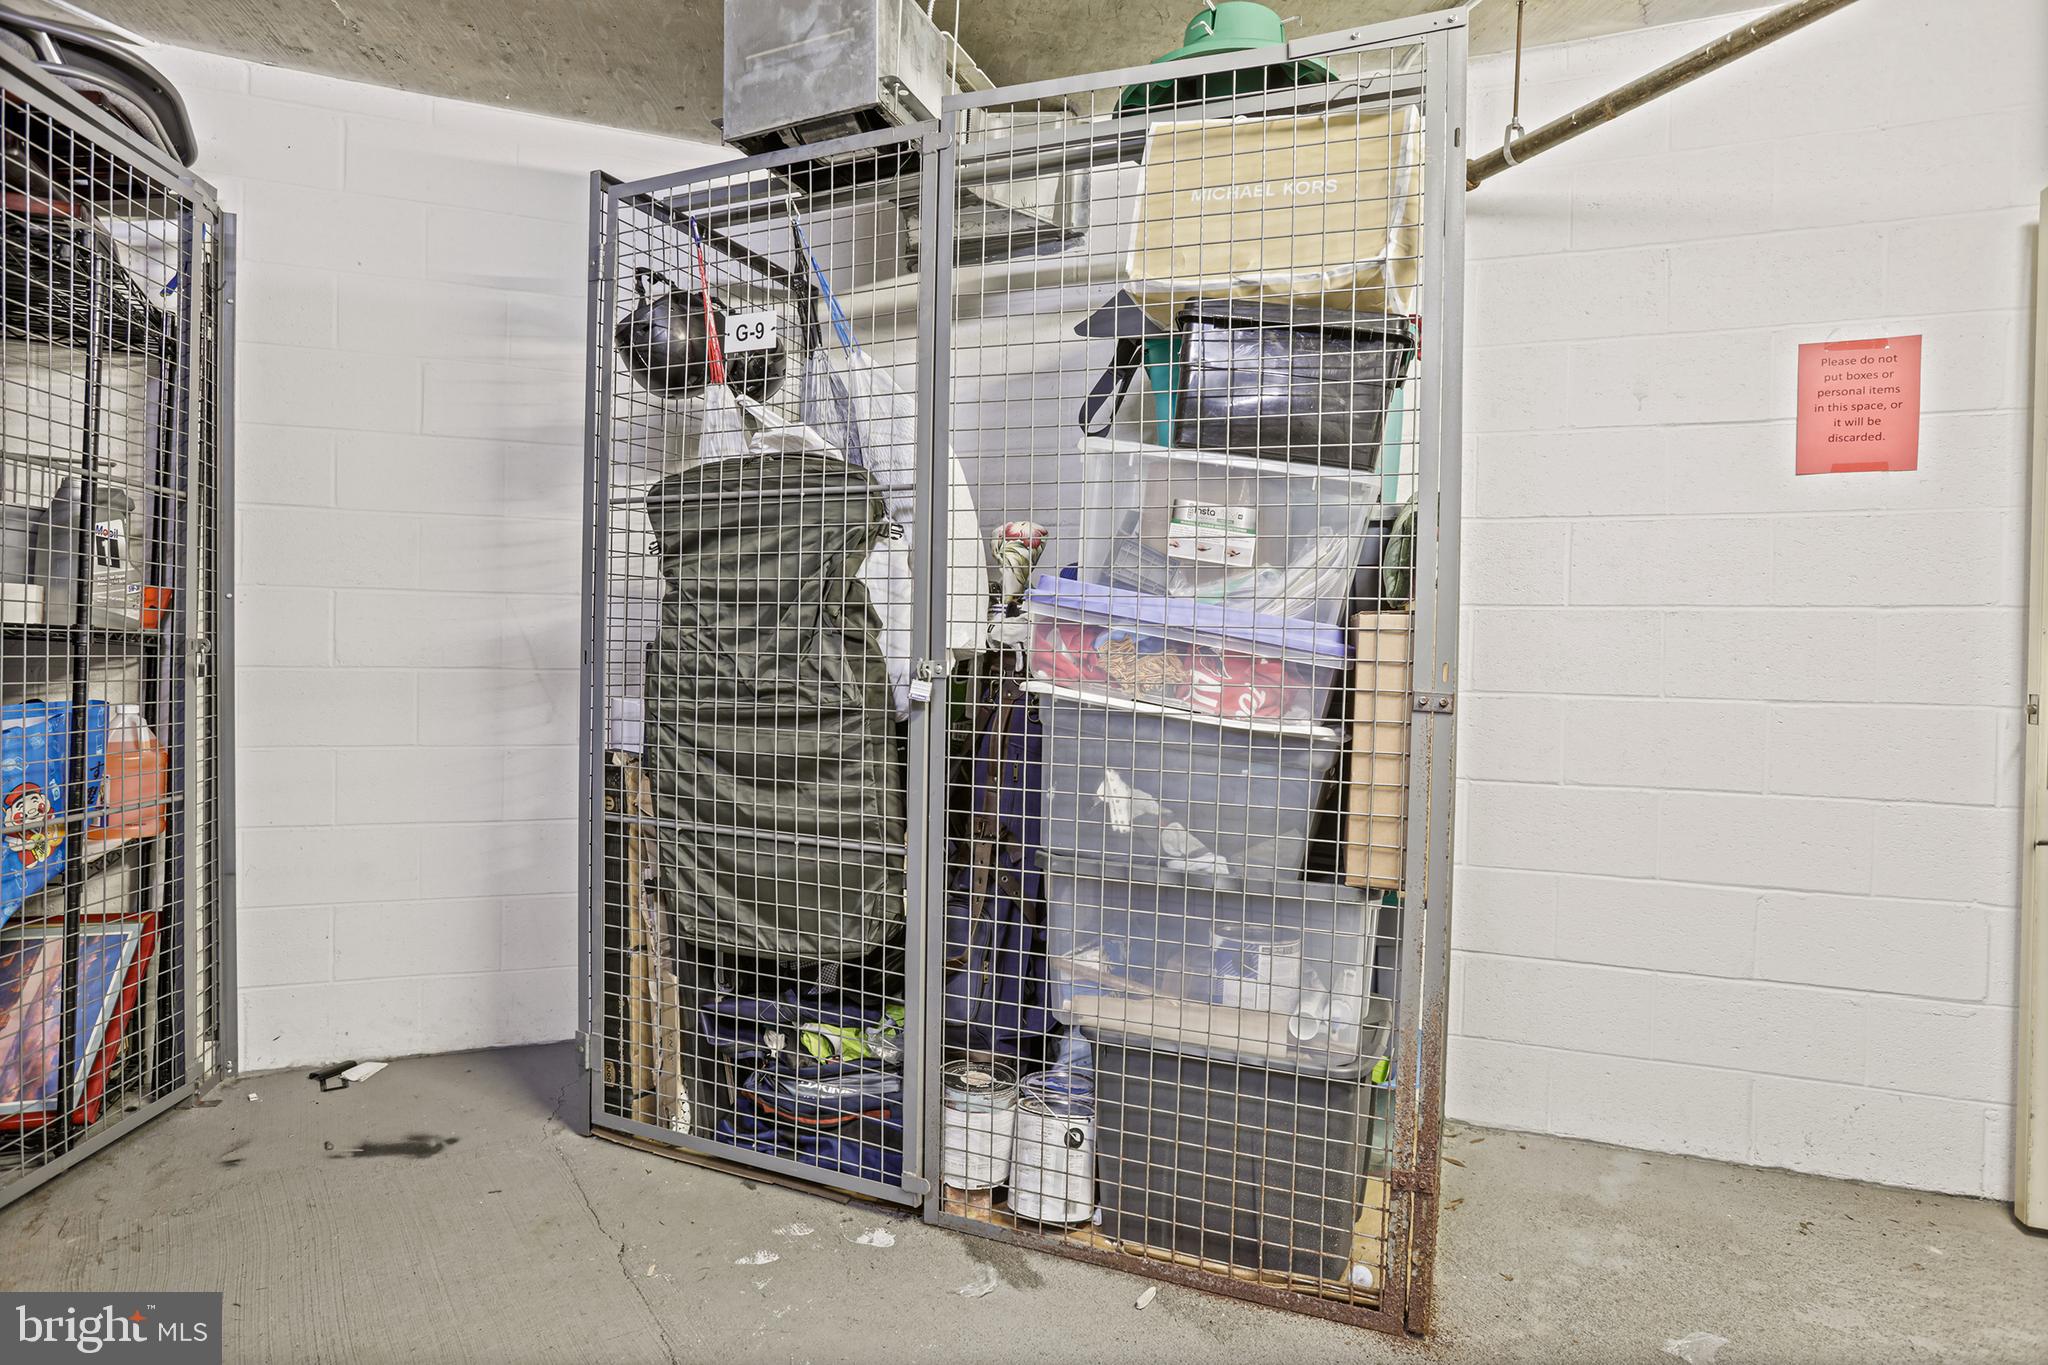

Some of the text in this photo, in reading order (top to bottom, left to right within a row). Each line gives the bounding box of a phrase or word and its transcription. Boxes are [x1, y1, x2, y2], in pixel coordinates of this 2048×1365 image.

[1191, 178, 1338, 202] MICHAEL KORS
[736, 322, 764, 342] G-9
[1821, 354, 1898, 366] Please do not
[1824, 371, 1894, 383] put boxes or
[1817, 385, 1901, 398] personal items
[1814, 401, 1903, 413] in this space, or
[1834, 417, 1882, 427] it will be
[1828, 432, 1885, 443] discarded.
